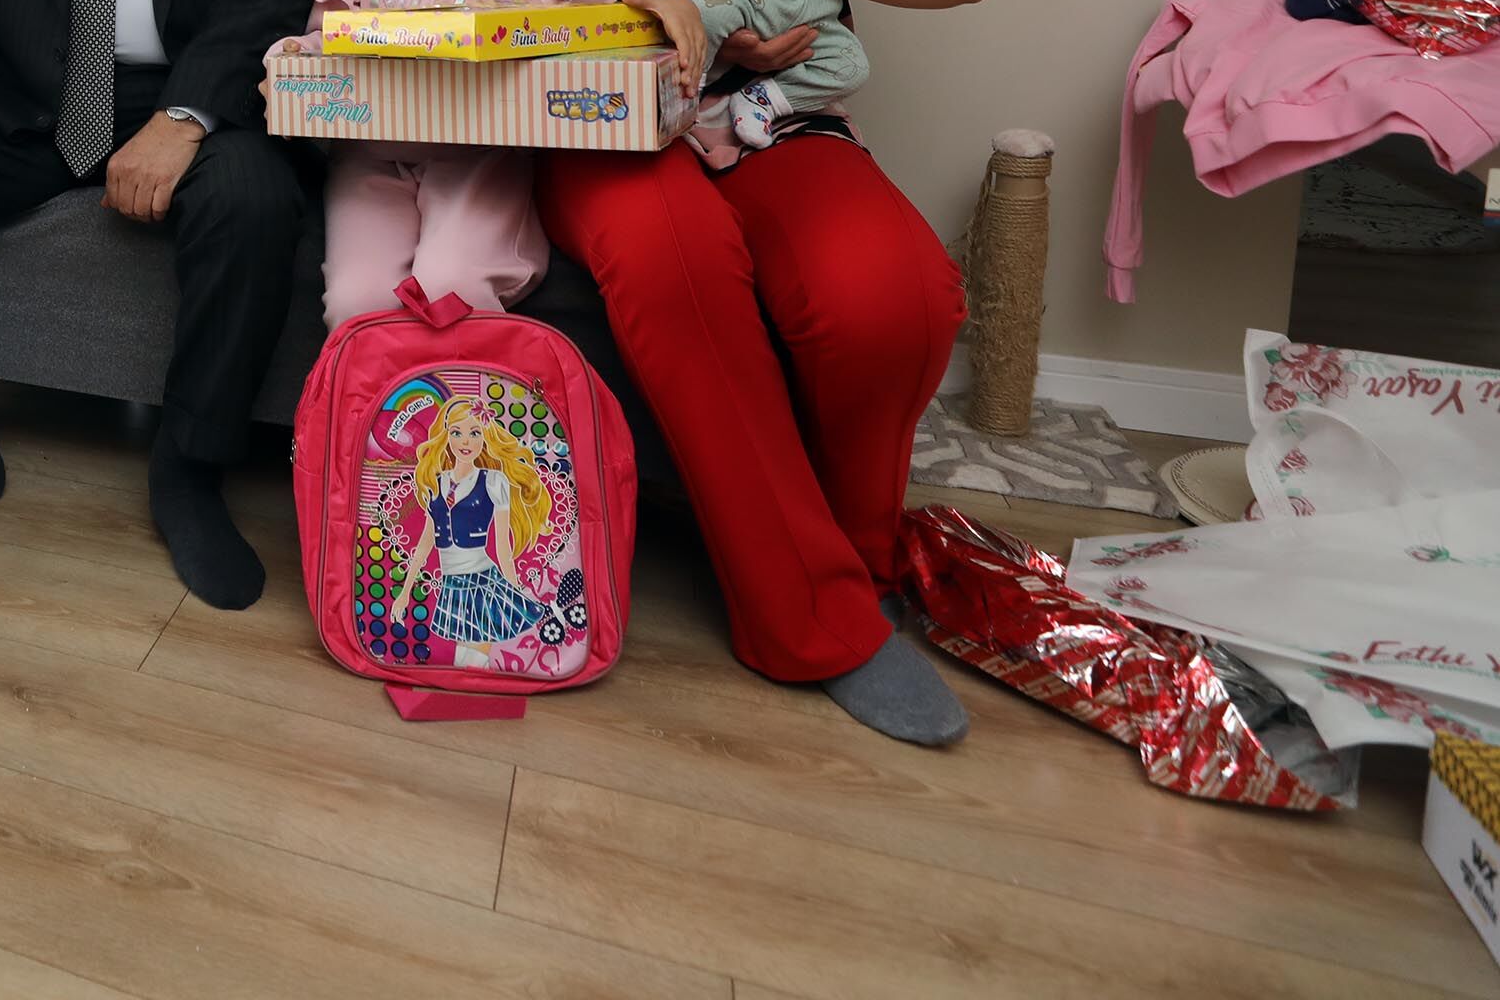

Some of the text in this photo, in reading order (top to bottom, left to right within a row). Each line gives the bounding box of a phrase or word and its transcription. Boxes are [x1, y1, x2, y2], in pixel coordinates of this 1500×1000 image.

[355, 27, 437, 50] Tina Baby
[511, 25, 571, 48] Tina Baby
[1363, 368, 1465, 415] Yaşar
[389, 396, 434, 438] ANGEL GIRLS
